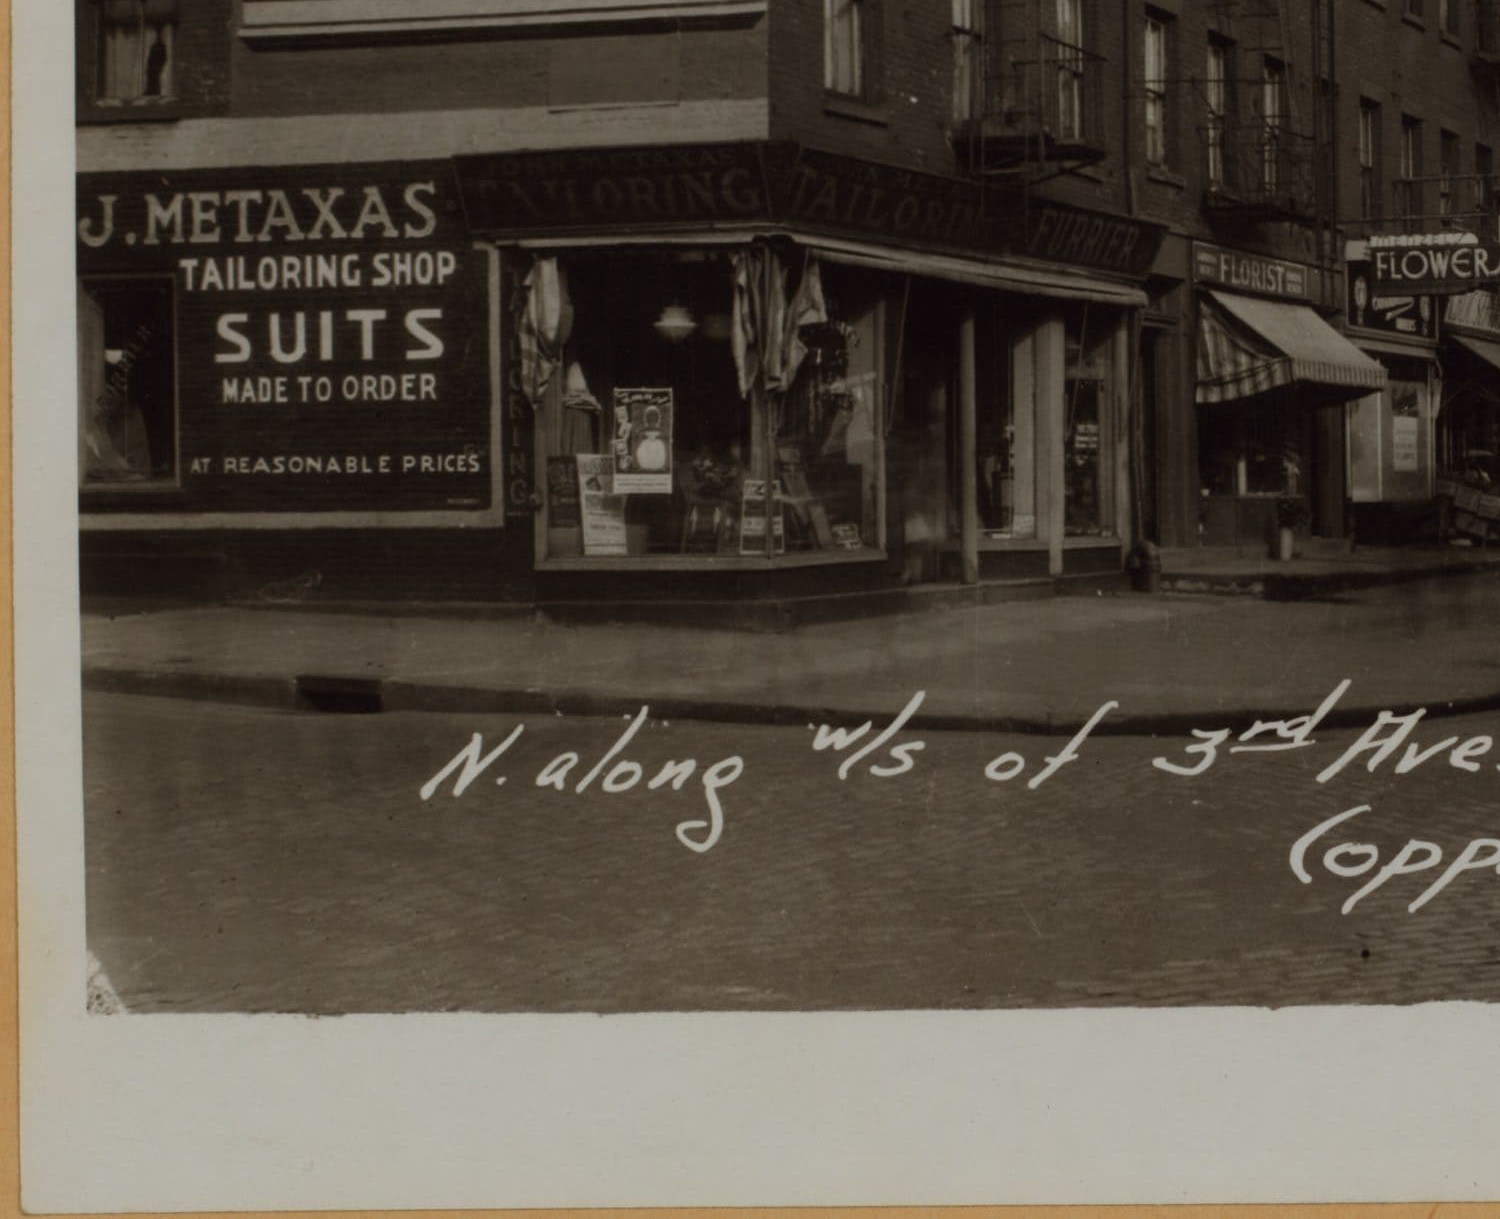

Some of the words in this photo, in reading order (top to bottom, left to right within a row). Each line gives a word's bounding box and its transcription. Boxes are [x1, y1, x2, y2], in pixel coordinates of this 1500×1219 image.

[1029, 208, 1140, 268] FURRIER
[178, 252, 361, 291] TAILORING
[371, 251, 456, 286] SHOP
[1219, 251, 1285, 293] FLORIST
[213, 308, 445, 364] SUITS
[221, 376, 288, 404] MADE
[299, 376, 332, 403] TO
[341, 373, 437, 401] ORDER
[189, 457, 212, 474] AT
[223, 455, 391, 475] REASONABLE
[402, 453, 481, 473] PRICES
